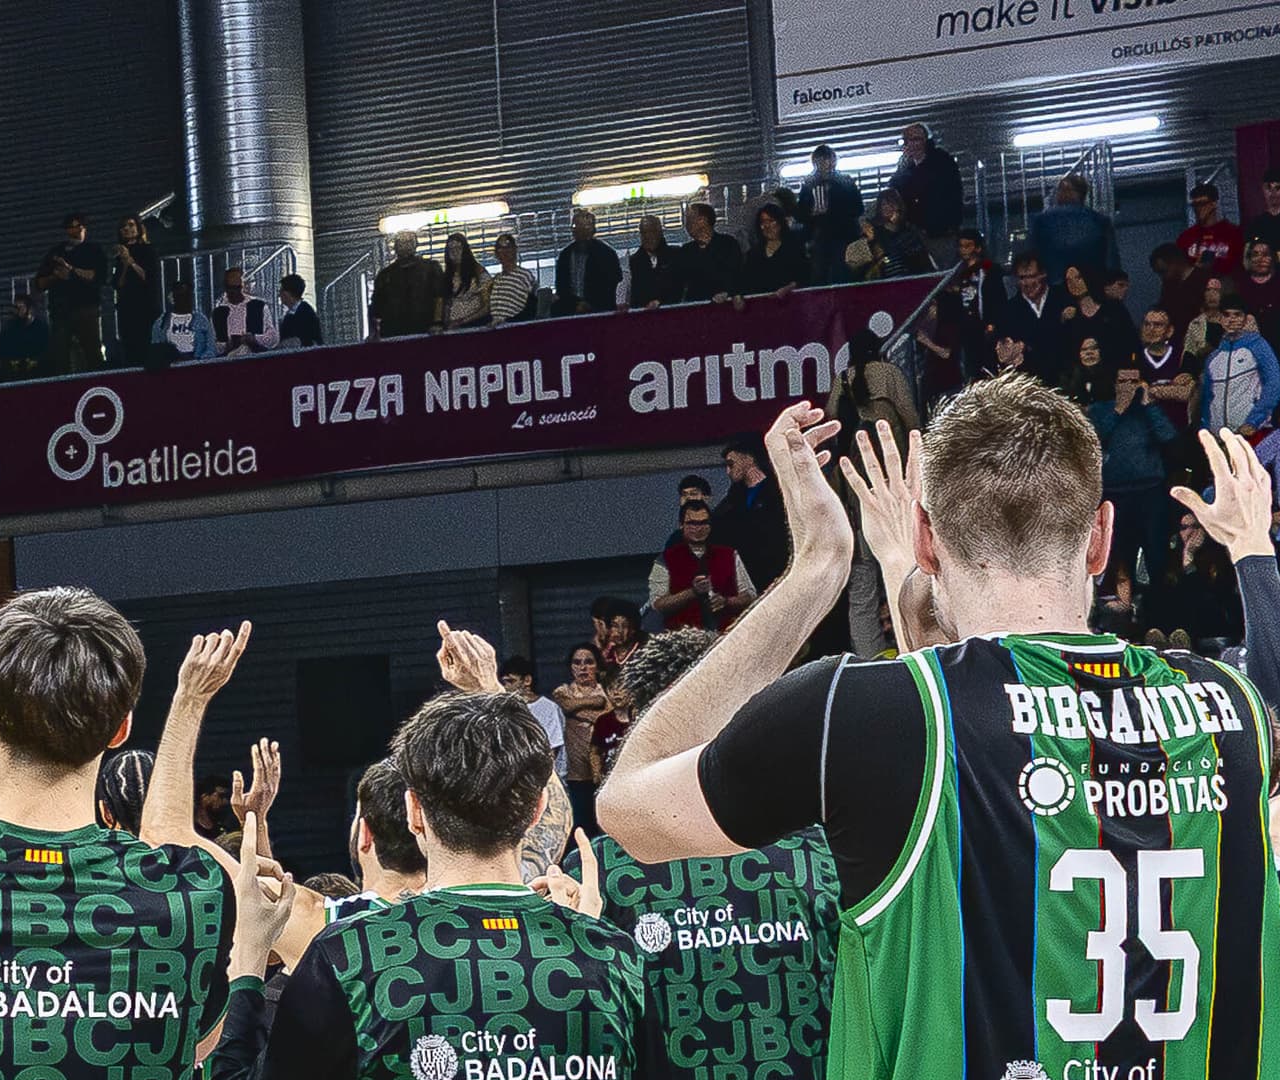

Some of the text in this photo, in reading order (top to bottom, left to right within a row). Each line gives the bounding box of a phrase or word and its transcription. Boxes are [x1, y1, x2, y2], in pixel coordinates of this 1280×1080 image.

[792, 81, 872, 105] falcon.cat
[292, 373, 404, 428] PIZZA
[102, 439, 258, 488] batlleida
[1003, 681, 1245, 745] BIRGANDER
[1083, 774, 1229, 818] PROBITAS
[674, 904, 735, 932] City of
[677, 918, 809, 951] BADALONA
[1046, 847, 1205, 1042] 35
[46, 962, 74, 985] of
[461, 1028, 536, 1056] City of
